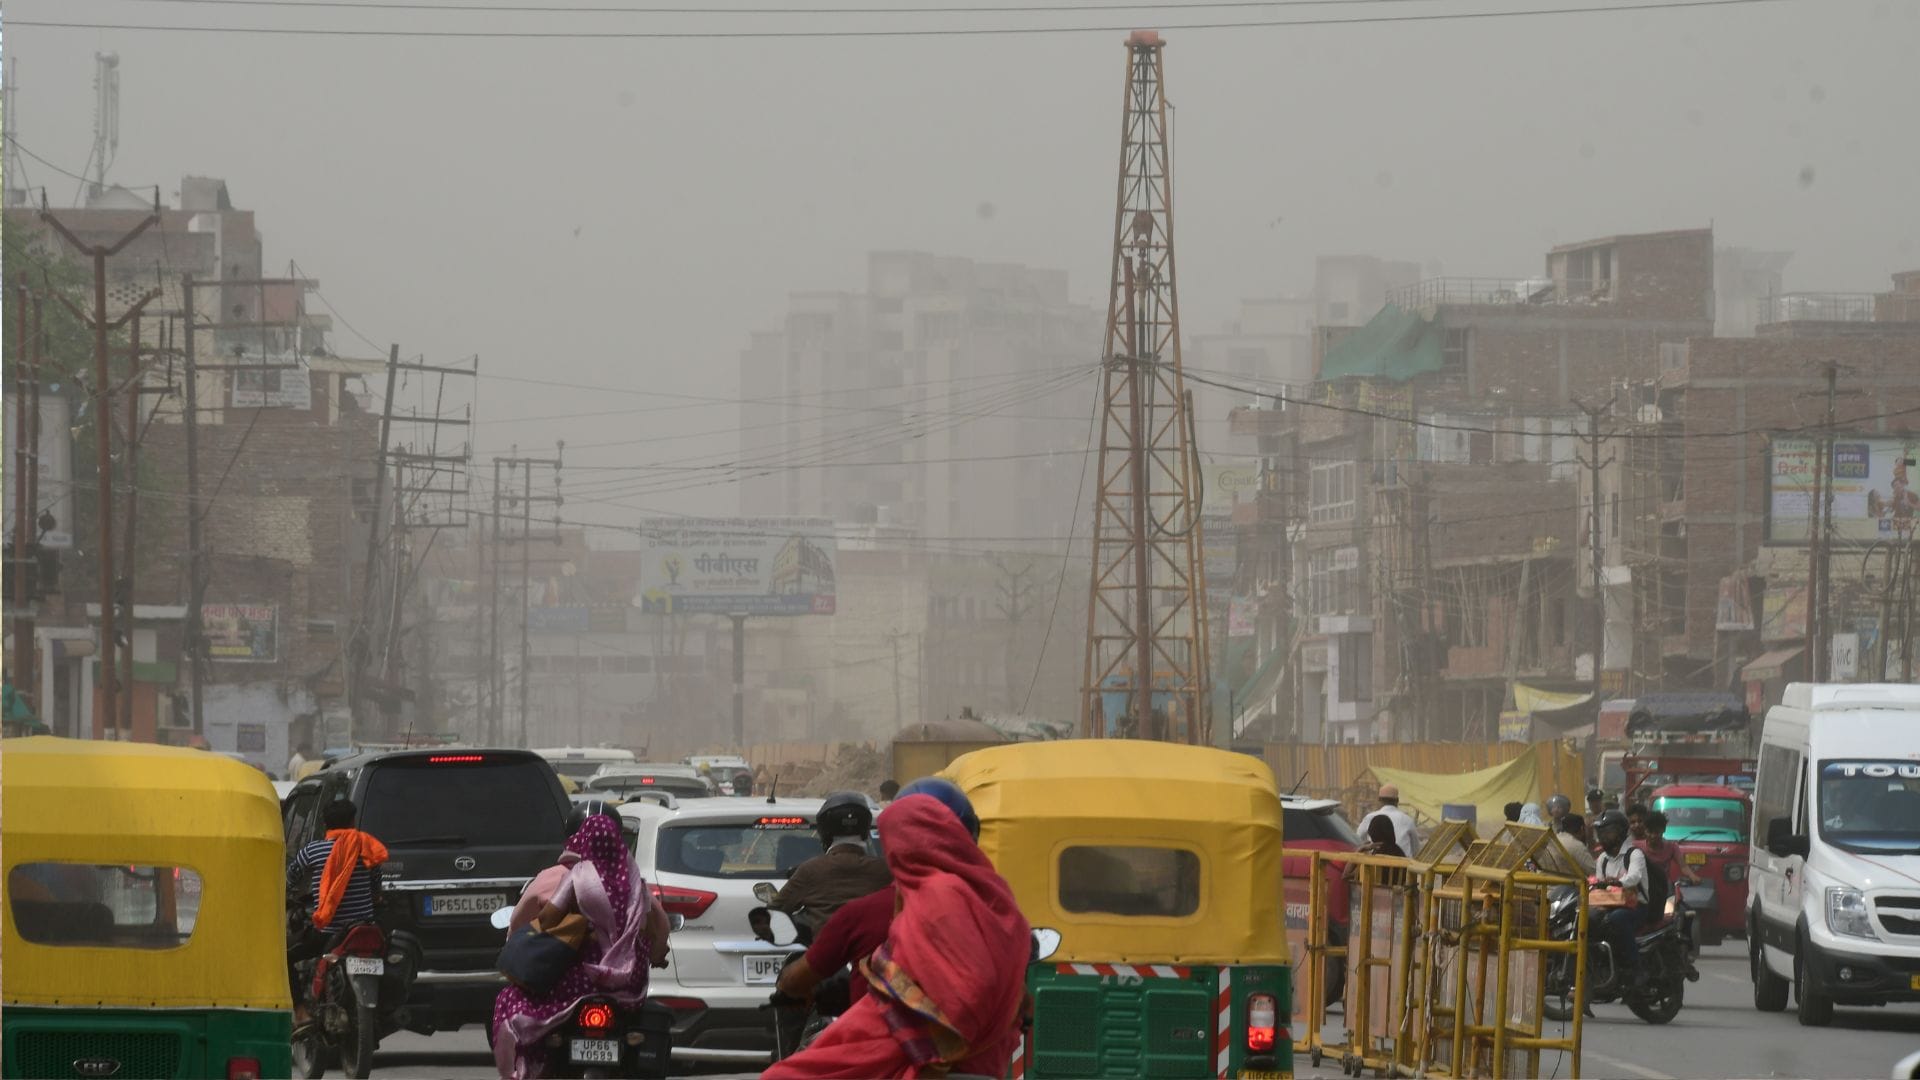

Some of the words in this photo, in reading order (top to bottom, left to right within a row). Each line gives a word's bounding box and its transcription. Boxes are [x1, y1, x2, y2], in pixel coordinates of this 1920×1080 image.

[693, 552, 760, 577] पीबीएस
[1838, 762, 1920, 779] TOU
[755, 959, 784, 975] UP6
[583, 1040, 610, 1051] UP66
